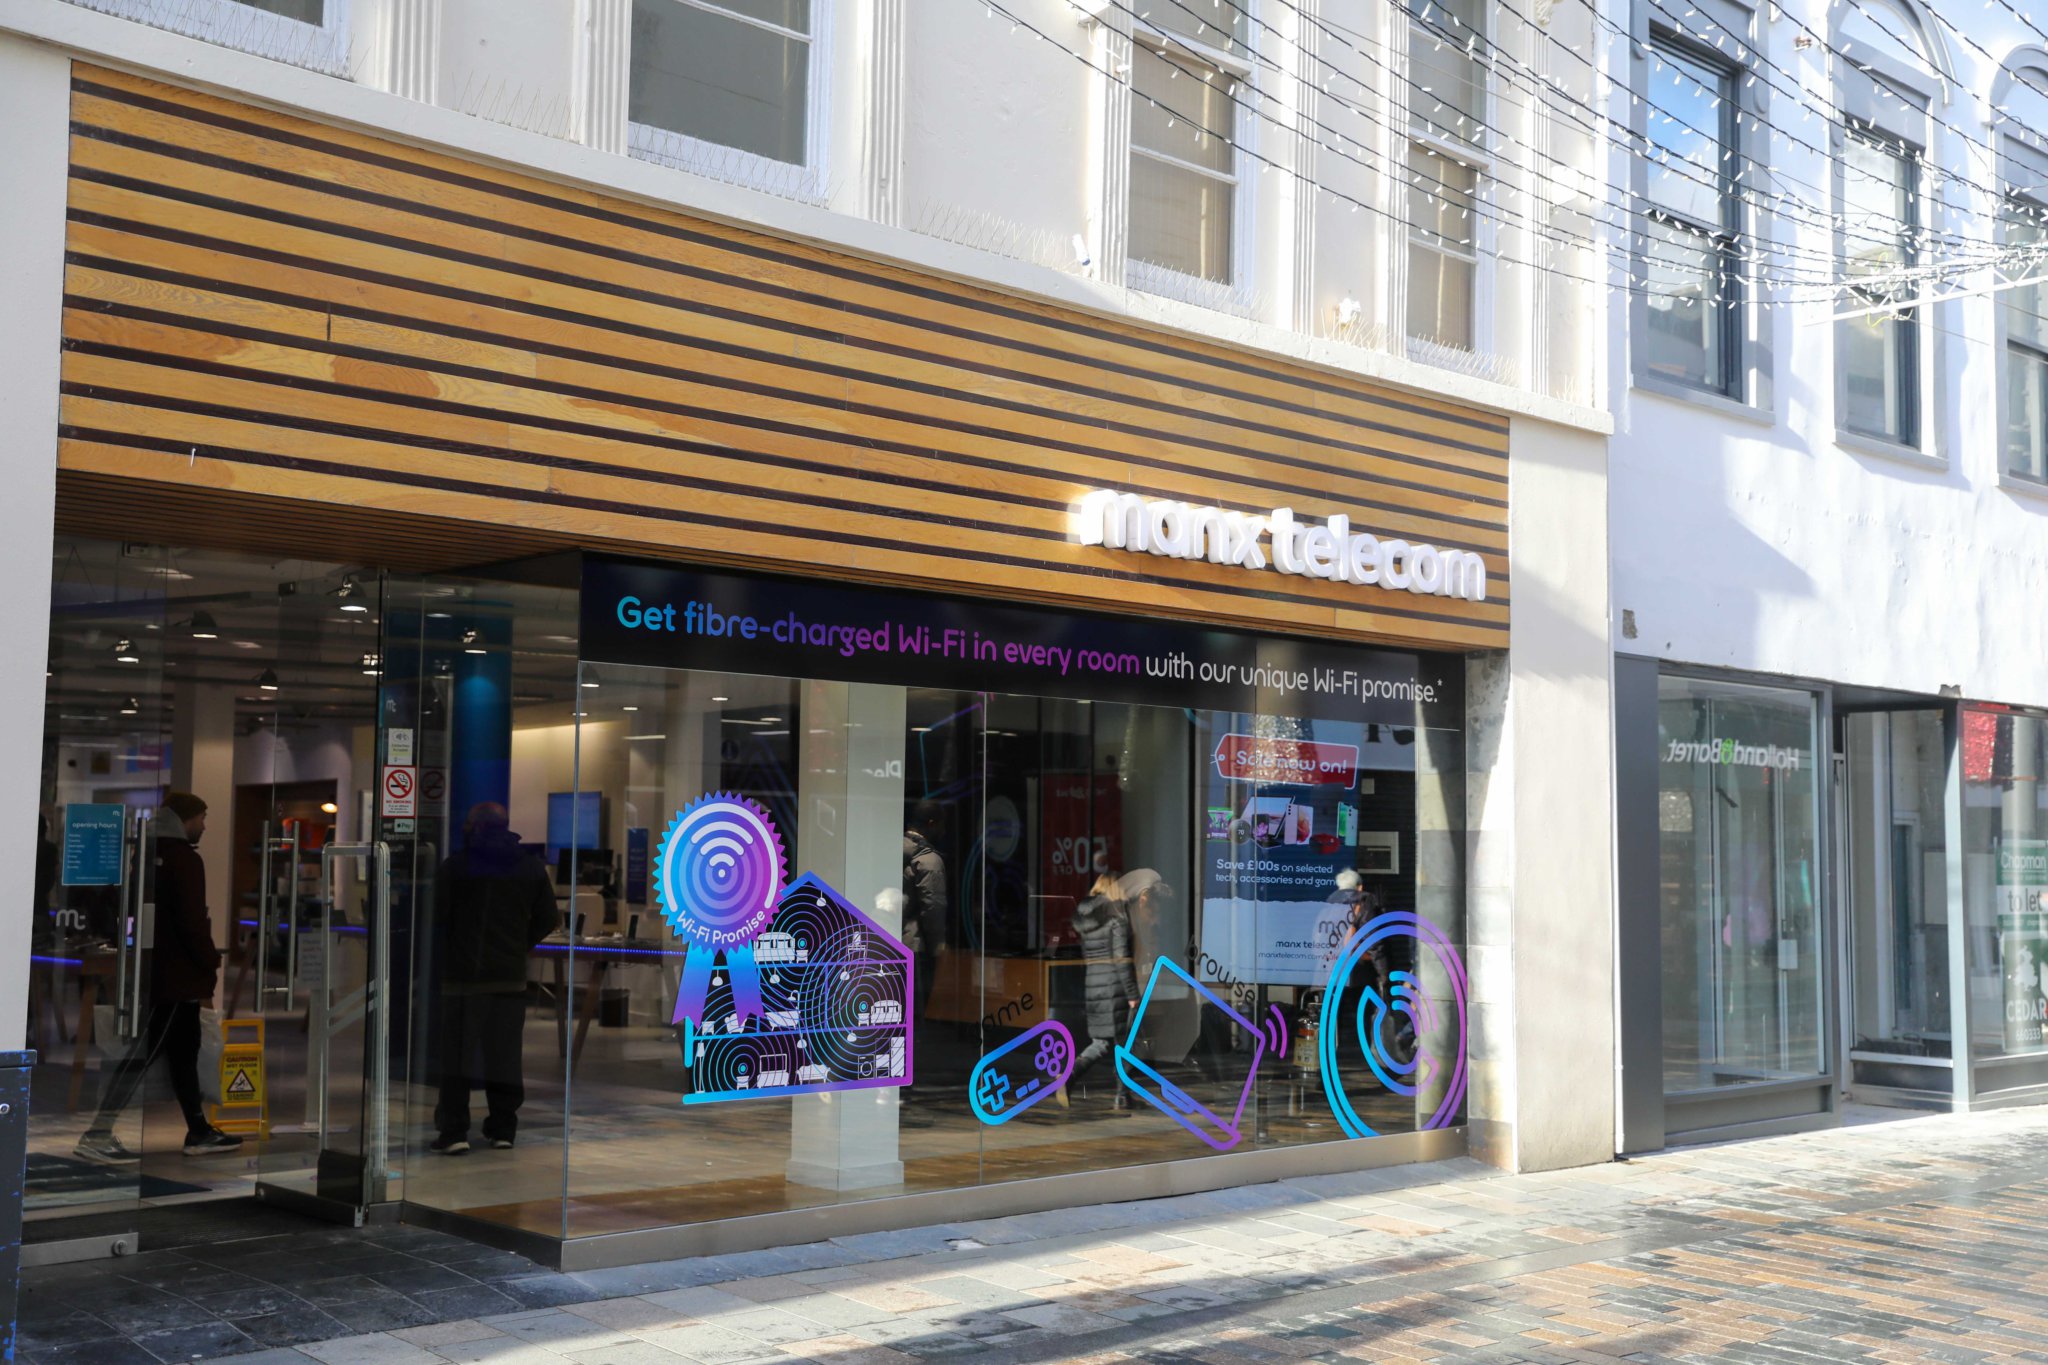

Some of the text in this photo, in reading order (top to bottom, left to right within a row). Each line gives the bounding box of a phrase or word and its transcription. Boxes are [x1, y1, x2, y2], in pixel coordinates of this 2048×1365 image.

[1079, 489, 1486, 602] manx telecom
[617, 595, 676, 632] Get
[684, 600, 890, 657] fibre-charged
[898, 623, 965, 658] Wi-Fi
[973, 631, 997, 662] in
[1003, 641, 1072, 676] every
[1077, 649, 1140, 675] room
[1145, 651, 1194, 680] with
[1199, 661, 1237, 684] our
[1240, 661, 1309, 696] unique
[1313, 667, 1358, 696] Wi-Fi
[1236, 750, 1347, 774] Sale now on!
[72, 822, 98, 830] opening
[1216, 858, 1245, 870] Save
[1281, 864, 1294, 872] on
[1295, 863, 1333, 873] selected
[1215, 872, 1238, 883] tech,
[1240, 875, 1293, 885] accessories
[1294, 876, 1313, 885] and
[2008, 888, 2043, 912] to let
[676, 910, 766, 945] Wi-Fi Promise
[1275, 940, 1301, 949] manx
[1184, 934, 1256, 1006] browse
[976, 993, 1034, 1048] ame
